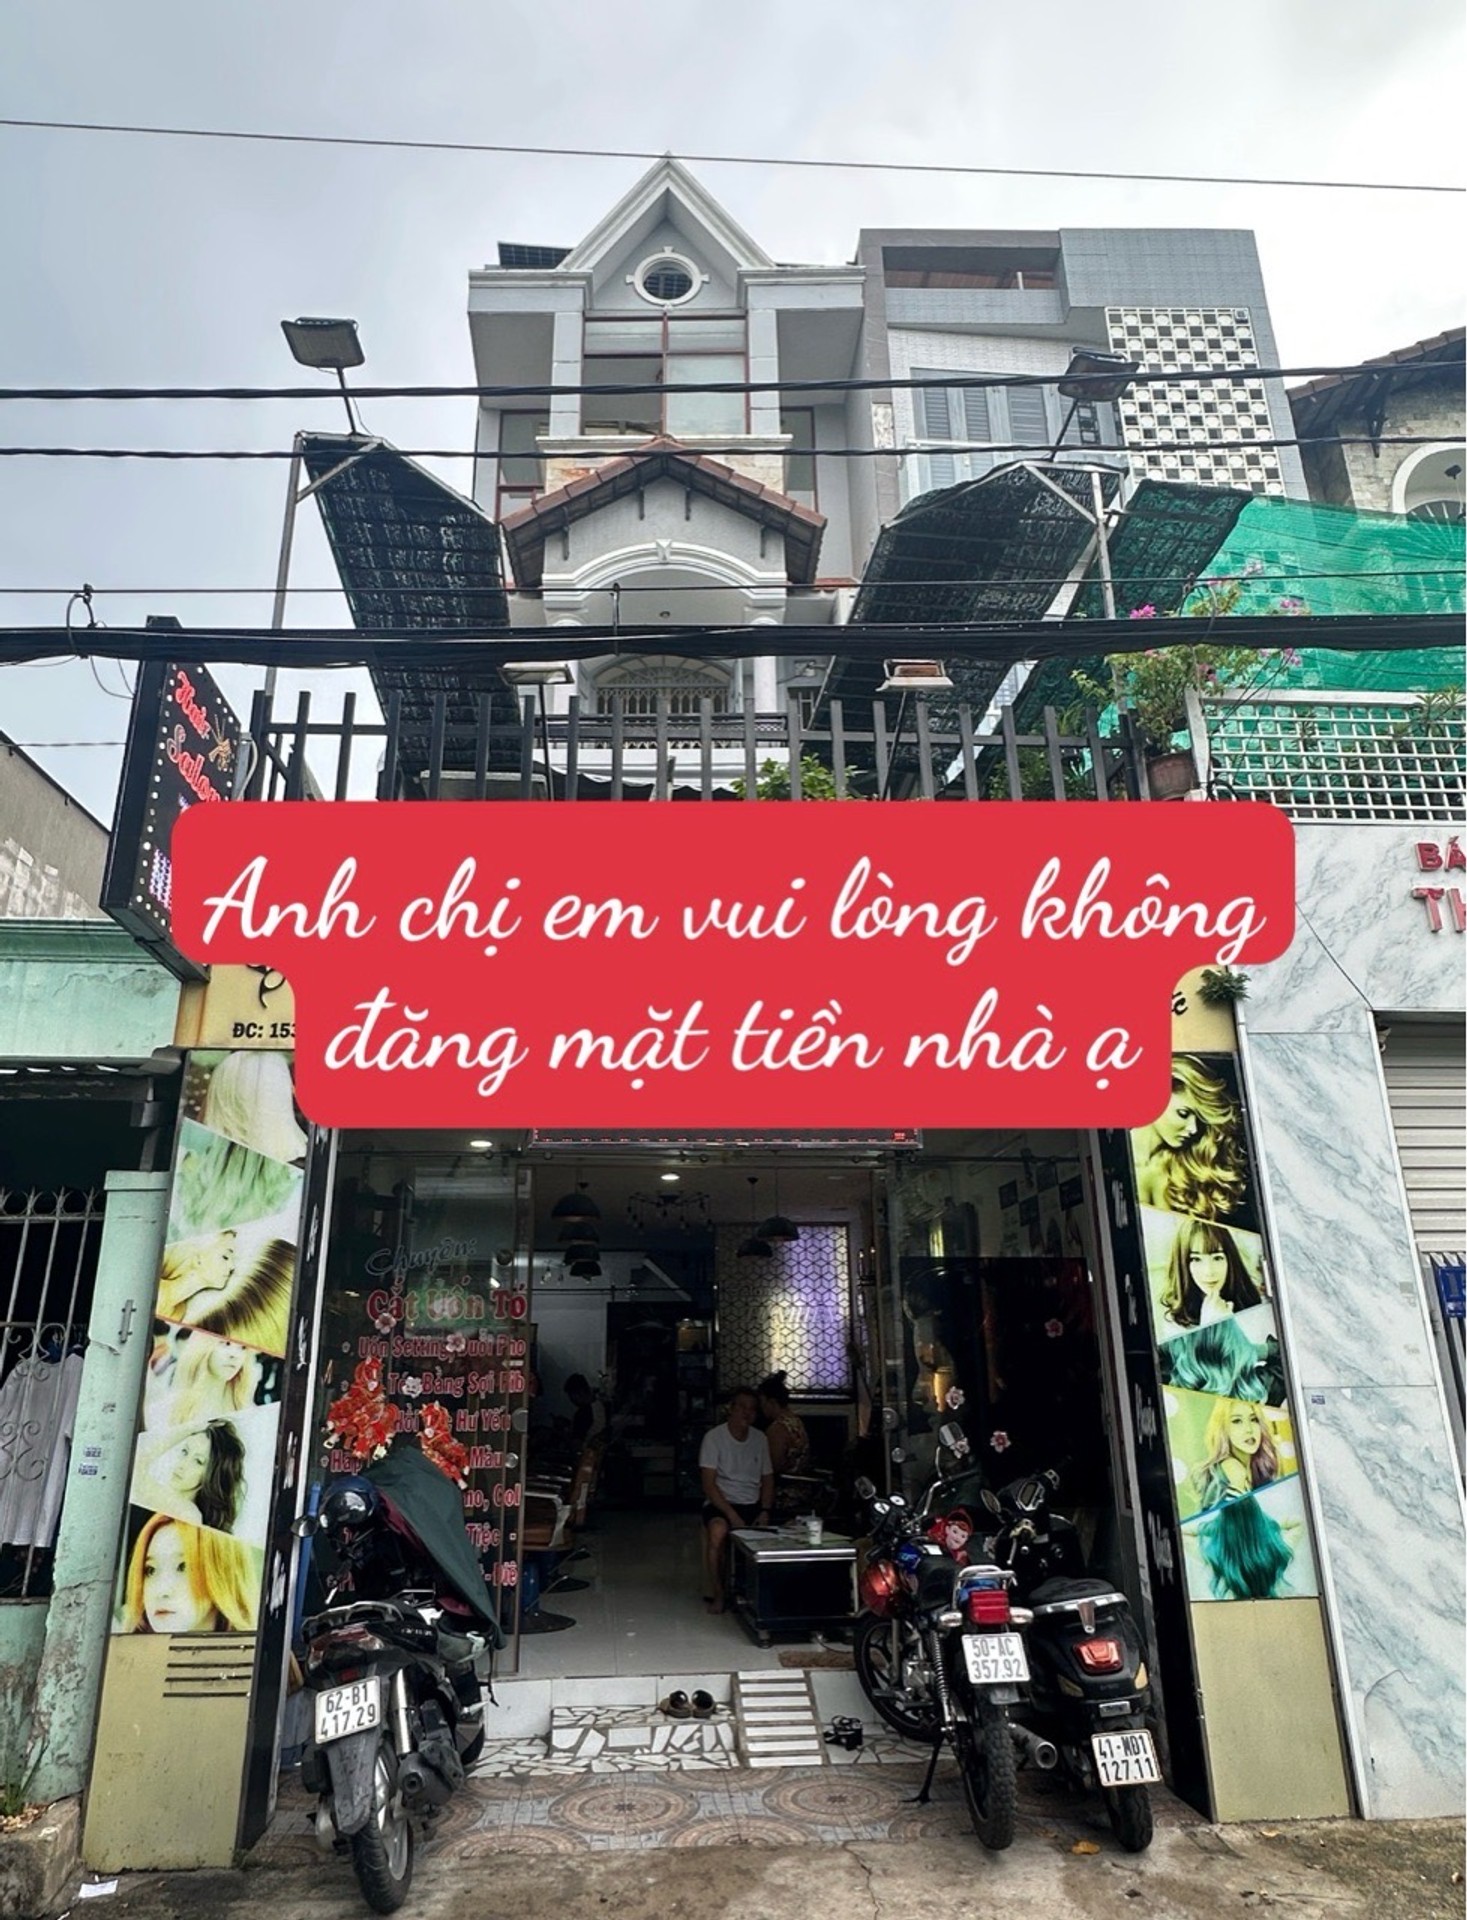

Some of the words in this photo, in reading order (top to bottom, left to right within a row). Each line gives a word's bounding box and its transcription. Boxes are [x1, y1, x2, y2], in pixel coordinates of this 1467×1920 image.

[232, 1022, 263, 1038] ĐC:
[972, 1638, 1014, 1657] 50-AC
[972, 1659, 1024, 1680] 357.92
[326, 1683, 368, 1713] 62-B1
[321, 1703, 376, 1736] 417.29
[1101, 1758, 1155, 1782] 127.11
